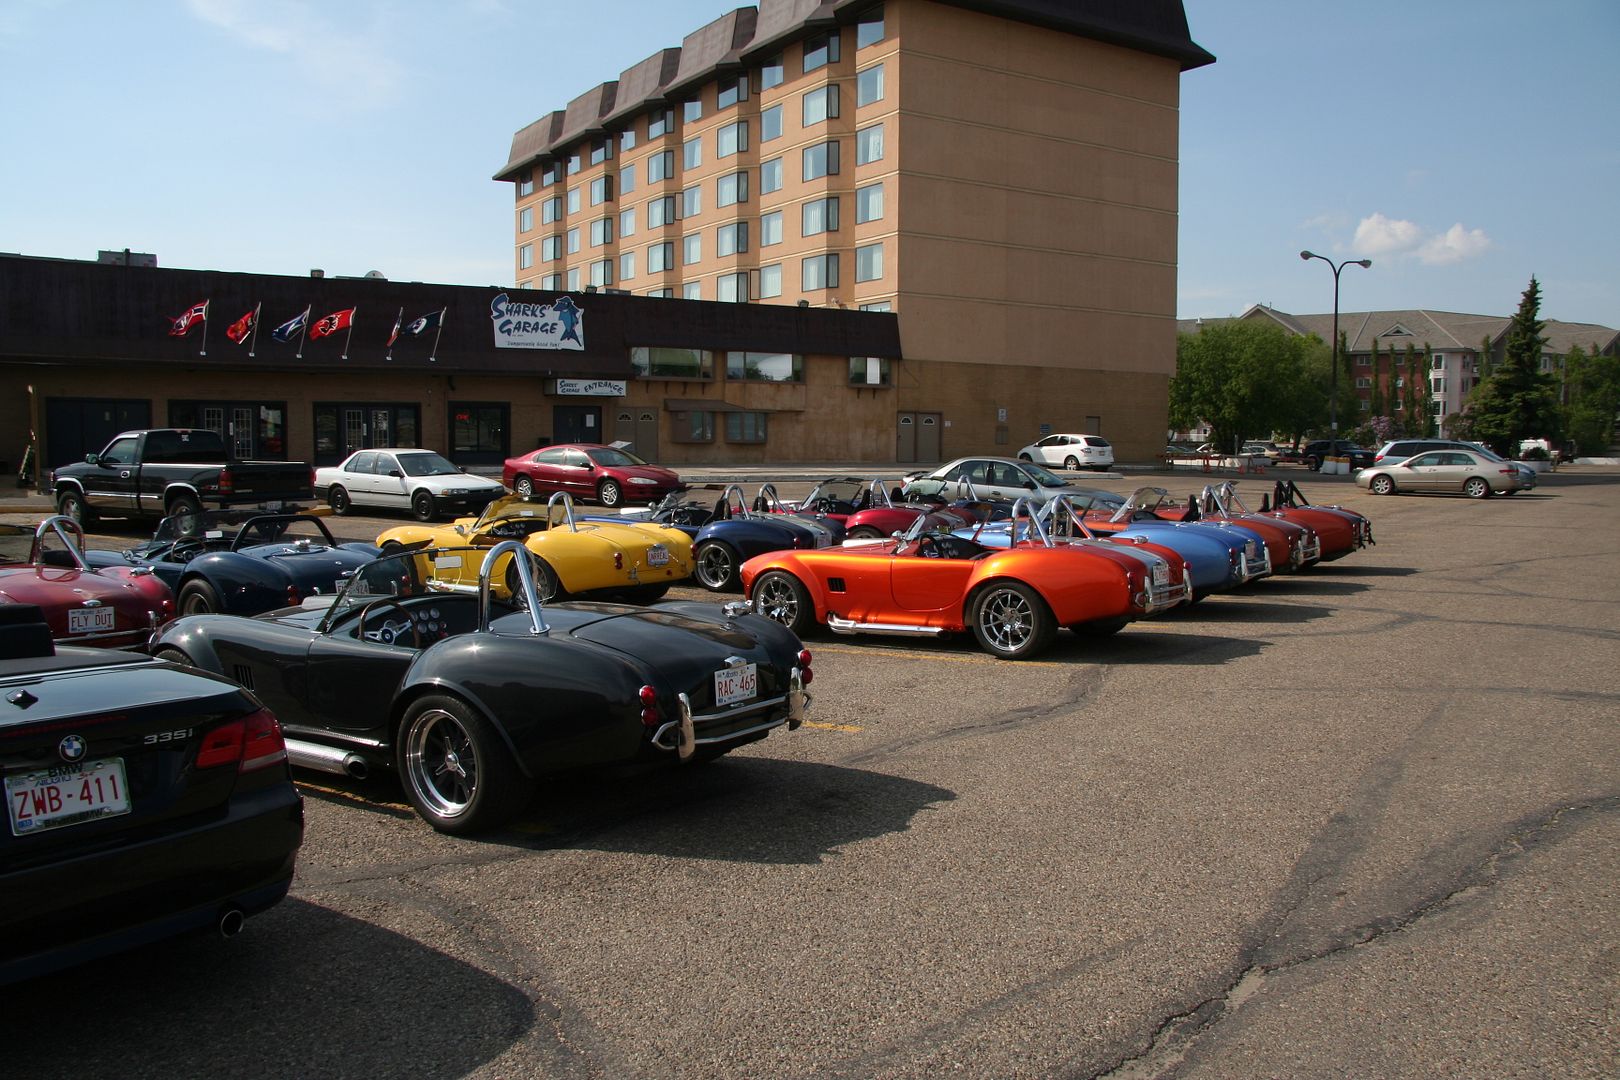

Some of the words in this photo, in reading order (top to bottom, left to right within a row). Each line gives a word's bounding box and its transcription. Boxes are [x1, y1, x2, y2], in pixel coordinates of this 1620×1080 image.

[498, 319, 559, 336] GARAGE
[584, 381, 624, 394] ENTRANCE
[71, 615, 89, 628] FLY
[143, 728, 193, 745] 335i
[48, 763, 83, 777] BMW
